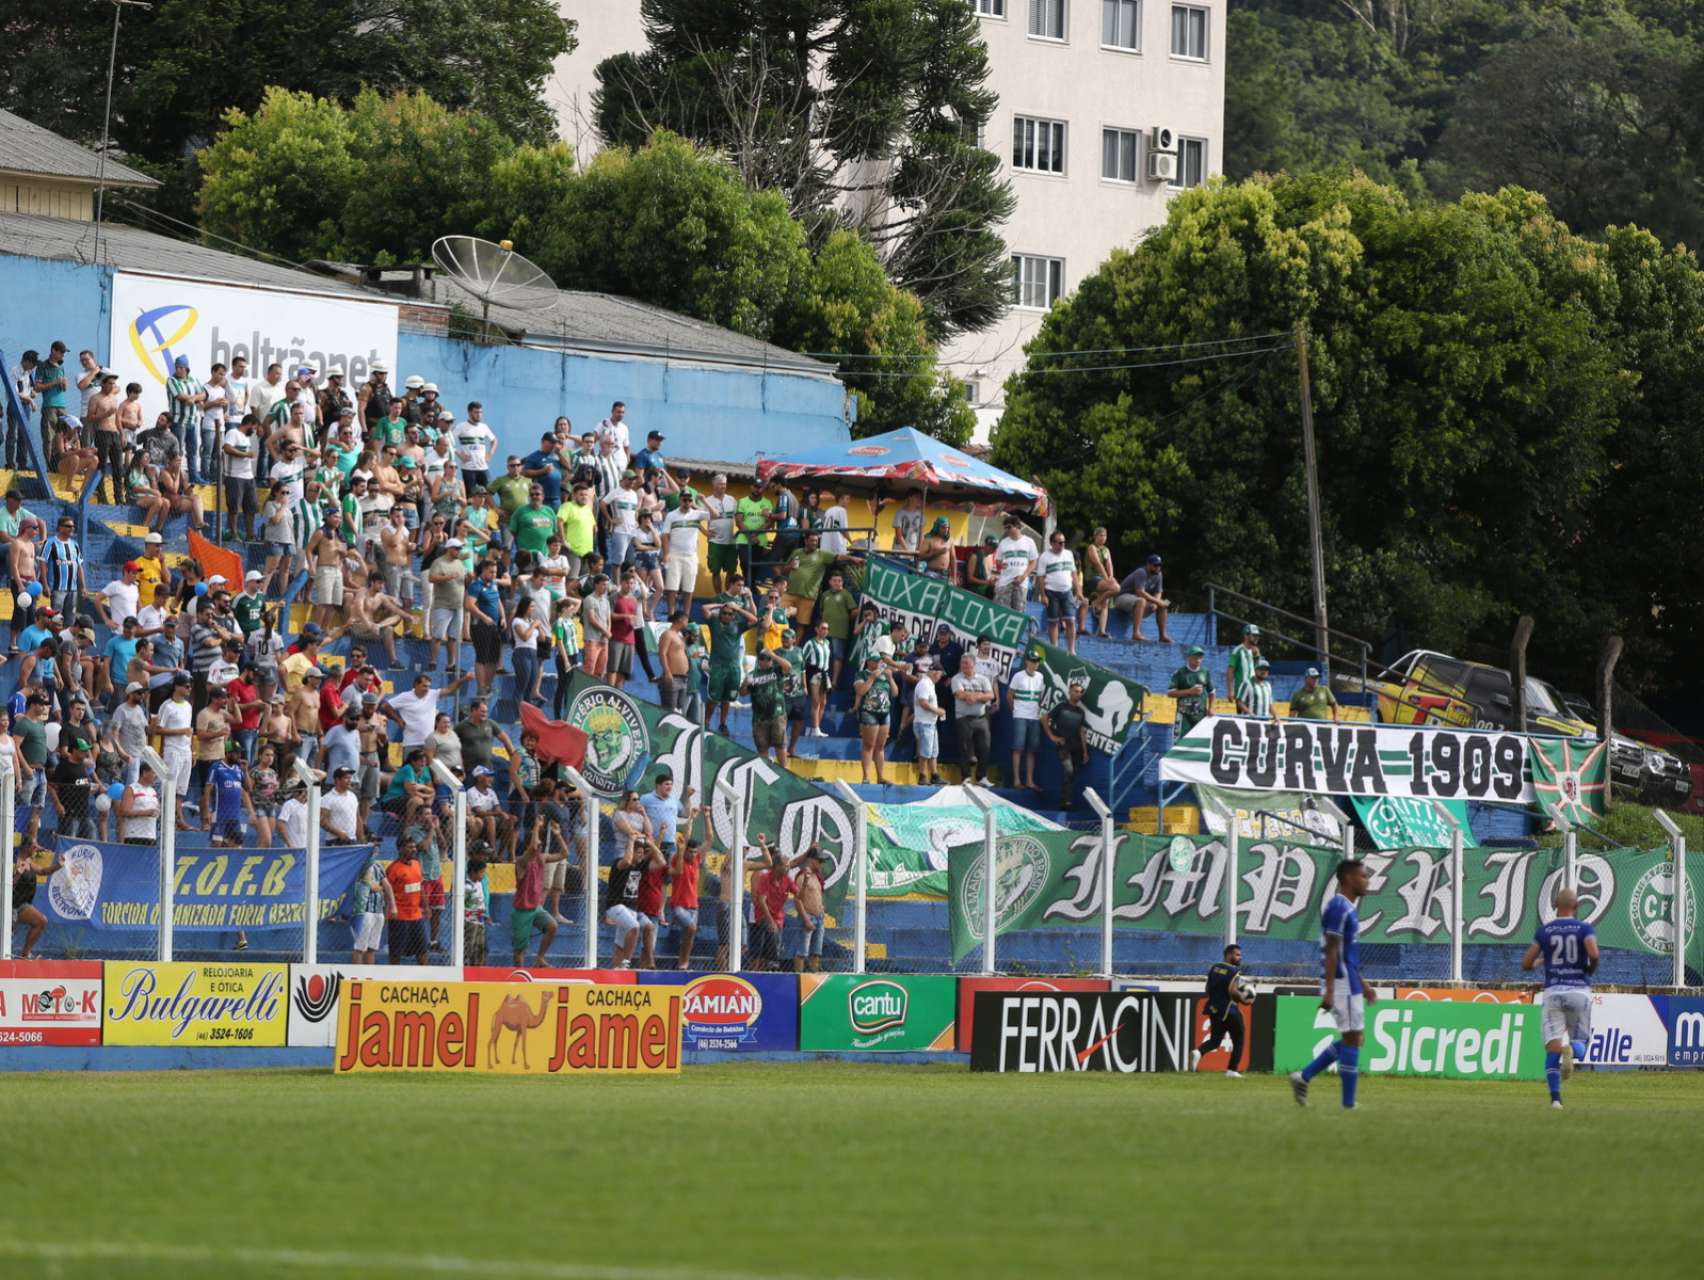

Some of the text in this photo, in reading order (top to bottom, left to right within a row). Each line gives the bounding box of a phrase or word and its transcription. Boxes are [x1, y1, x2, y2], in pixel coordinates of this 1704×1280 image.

[868, 563, 1024, 643] COXA COXA
[1085, 729, 1122, 756] ENTES
[1211, 719, 1525, 800] CURVA 1909
[150, 903, 227, 926] OANIZADA
[1550, 934, 1578, 965] 20
[203, 967, 254, 978] RELOJOARIA
[211, 982, 216, 992] E
[109, 967, 284, 1039] Bulgarelli
[380, 986, 449, 1008] CACHAÇA
[586, 989, 651, 1011] CACHAÇA
[682, 994, 758, 1015] DAMIANI
[340, 982, 480, 1072] jamel
[548, 986, 681, 1073] jamel
[1000, 995, 1191, 1073] FERRACINI
[1370, 1008, 1524, 1074] Sicredi
